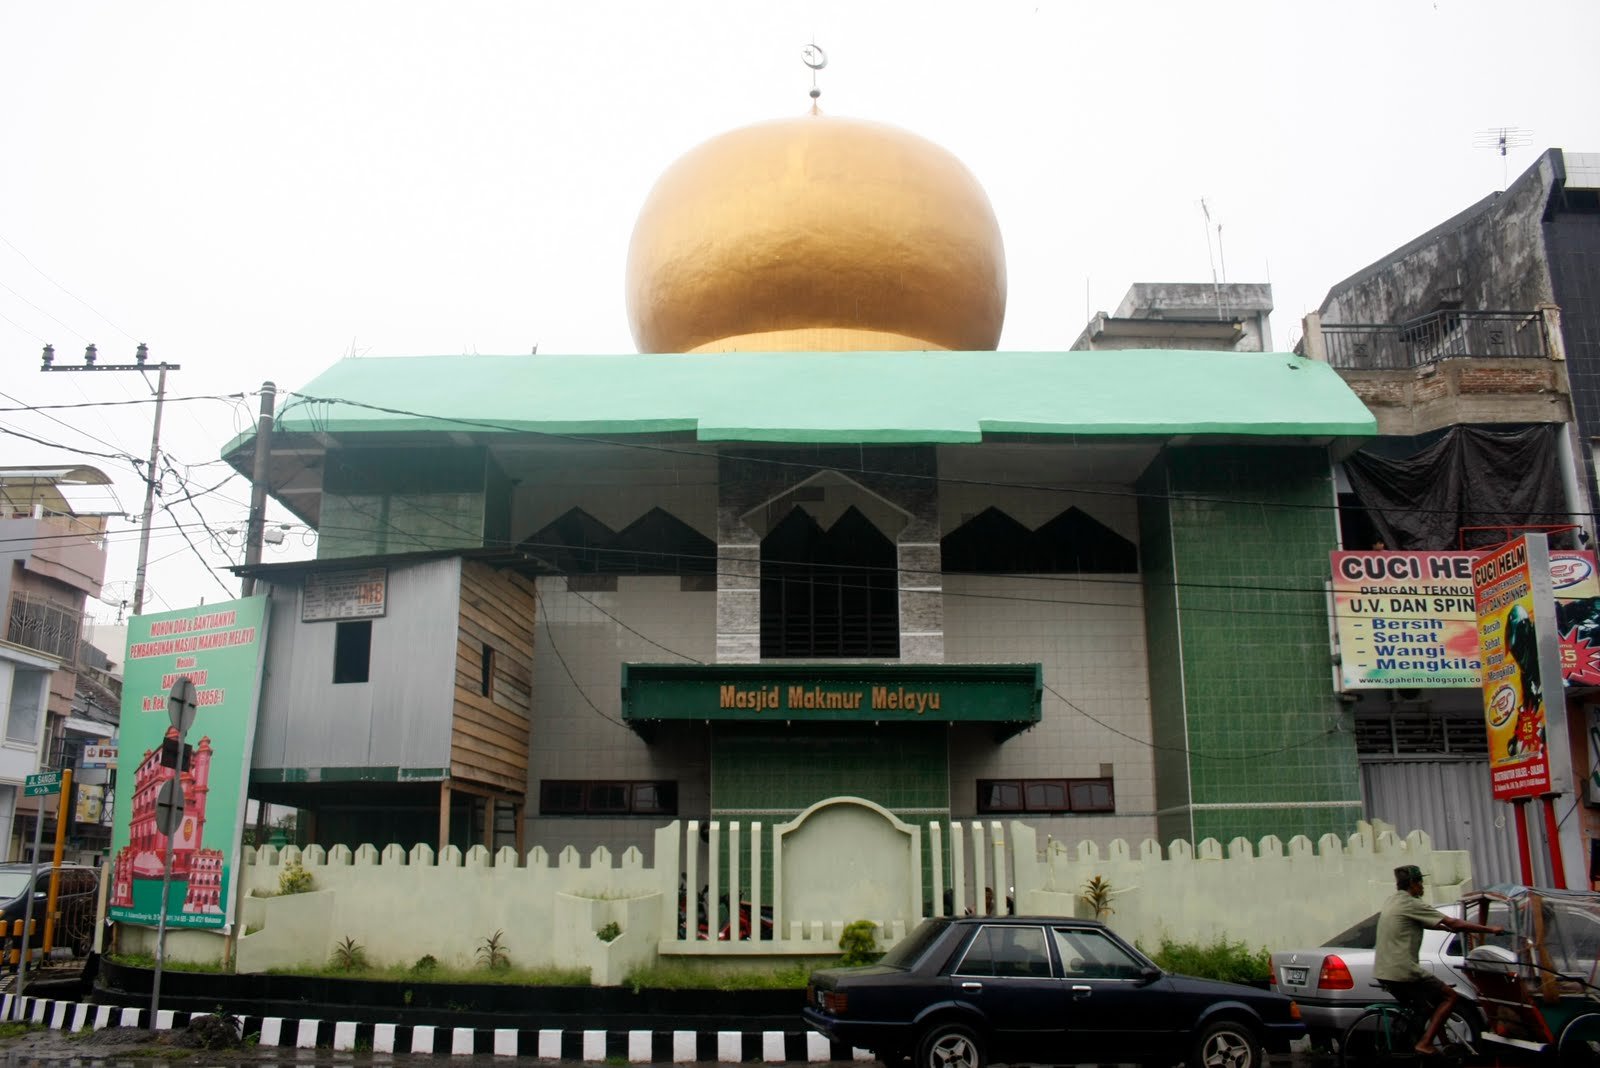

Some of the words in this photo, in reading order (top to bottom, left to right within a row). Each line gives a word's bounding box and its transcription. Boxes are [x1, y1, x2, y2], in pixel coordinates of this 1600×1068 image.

[1340, 556, 1421, 580] CUCI
[1428, 556, 1480, 580] HE
[1474, 559, 1496, 587] CUCI
[1498, 543, 1526, 575] HELM
[1360, 586, 1418, 595] DENGAN
[1350, 599, 1384, 612] U.V.
[1391, 599, 1427, 612] DAN
[174, 618, 187, 633] DOA
[1372, 618, 1443, 630] Bersih
[1373, 632, 1438, 643] Sehat
[1374, 645, 1445, 658] Wangi
[720, 685, 779, 711] Masjid
[788, 686, 863, 709] Makmur
[871, 686, 940, 714] Melayu
